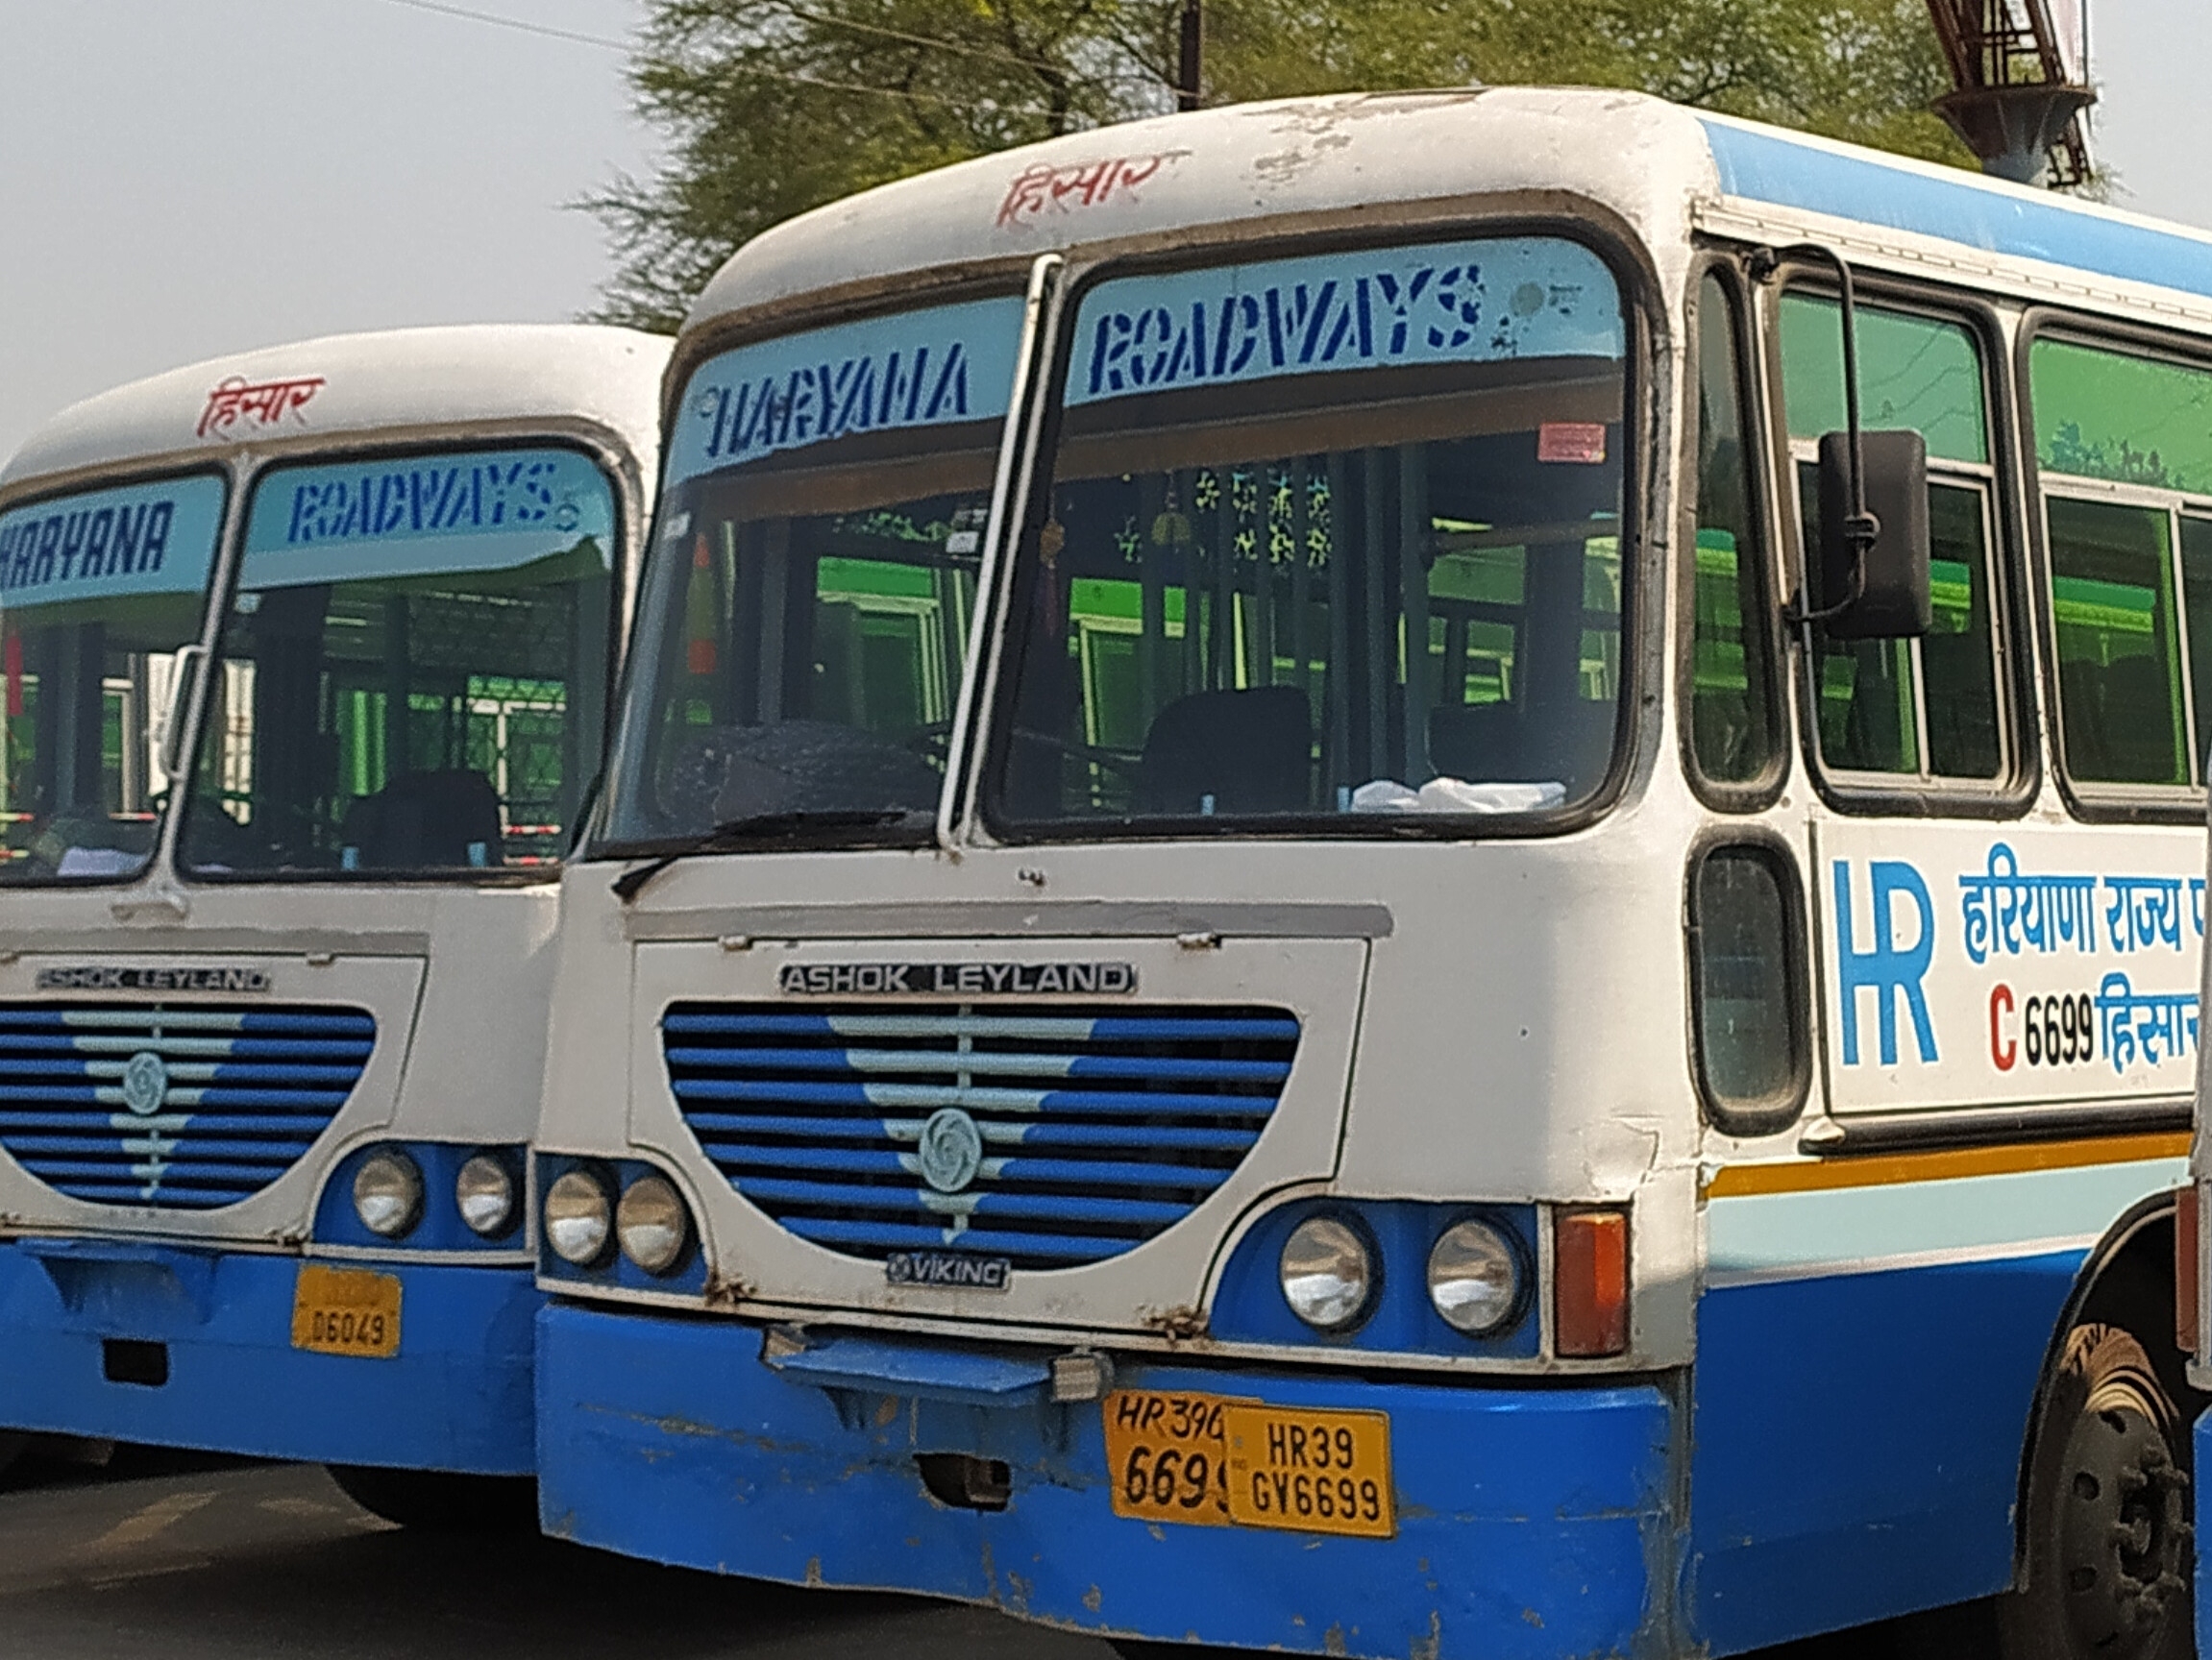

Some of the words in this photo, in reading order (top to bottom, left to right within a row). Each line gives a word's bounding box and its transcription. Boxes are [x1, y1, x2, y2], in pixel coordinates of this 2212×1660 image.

[1089, 264, 1486, 395] ROADWAYS
[197, 375, 327, 438] हिसार
[289, 462, 555, 541] ROADWAYS
[0, 500, 175, 590] HARYANA
[1958, 842, 2097, 964] हरियाणा
[2103, 876, 2181, 953] राज्य
[138, 968, 269, 990] LEYLAND
[784, 964, 911, 992] ASHOK
[935, 964, 1128, 993] LEYLAND
[1990, 984, 2016, 1071] C
[2025, 993, 2094, 1065] 6699
[913, 1258, 1002, 1284] VIKING
[1268, 1424, 1353, 1470] HR39
[1252, 1471, 1381, 1522] GV6699
